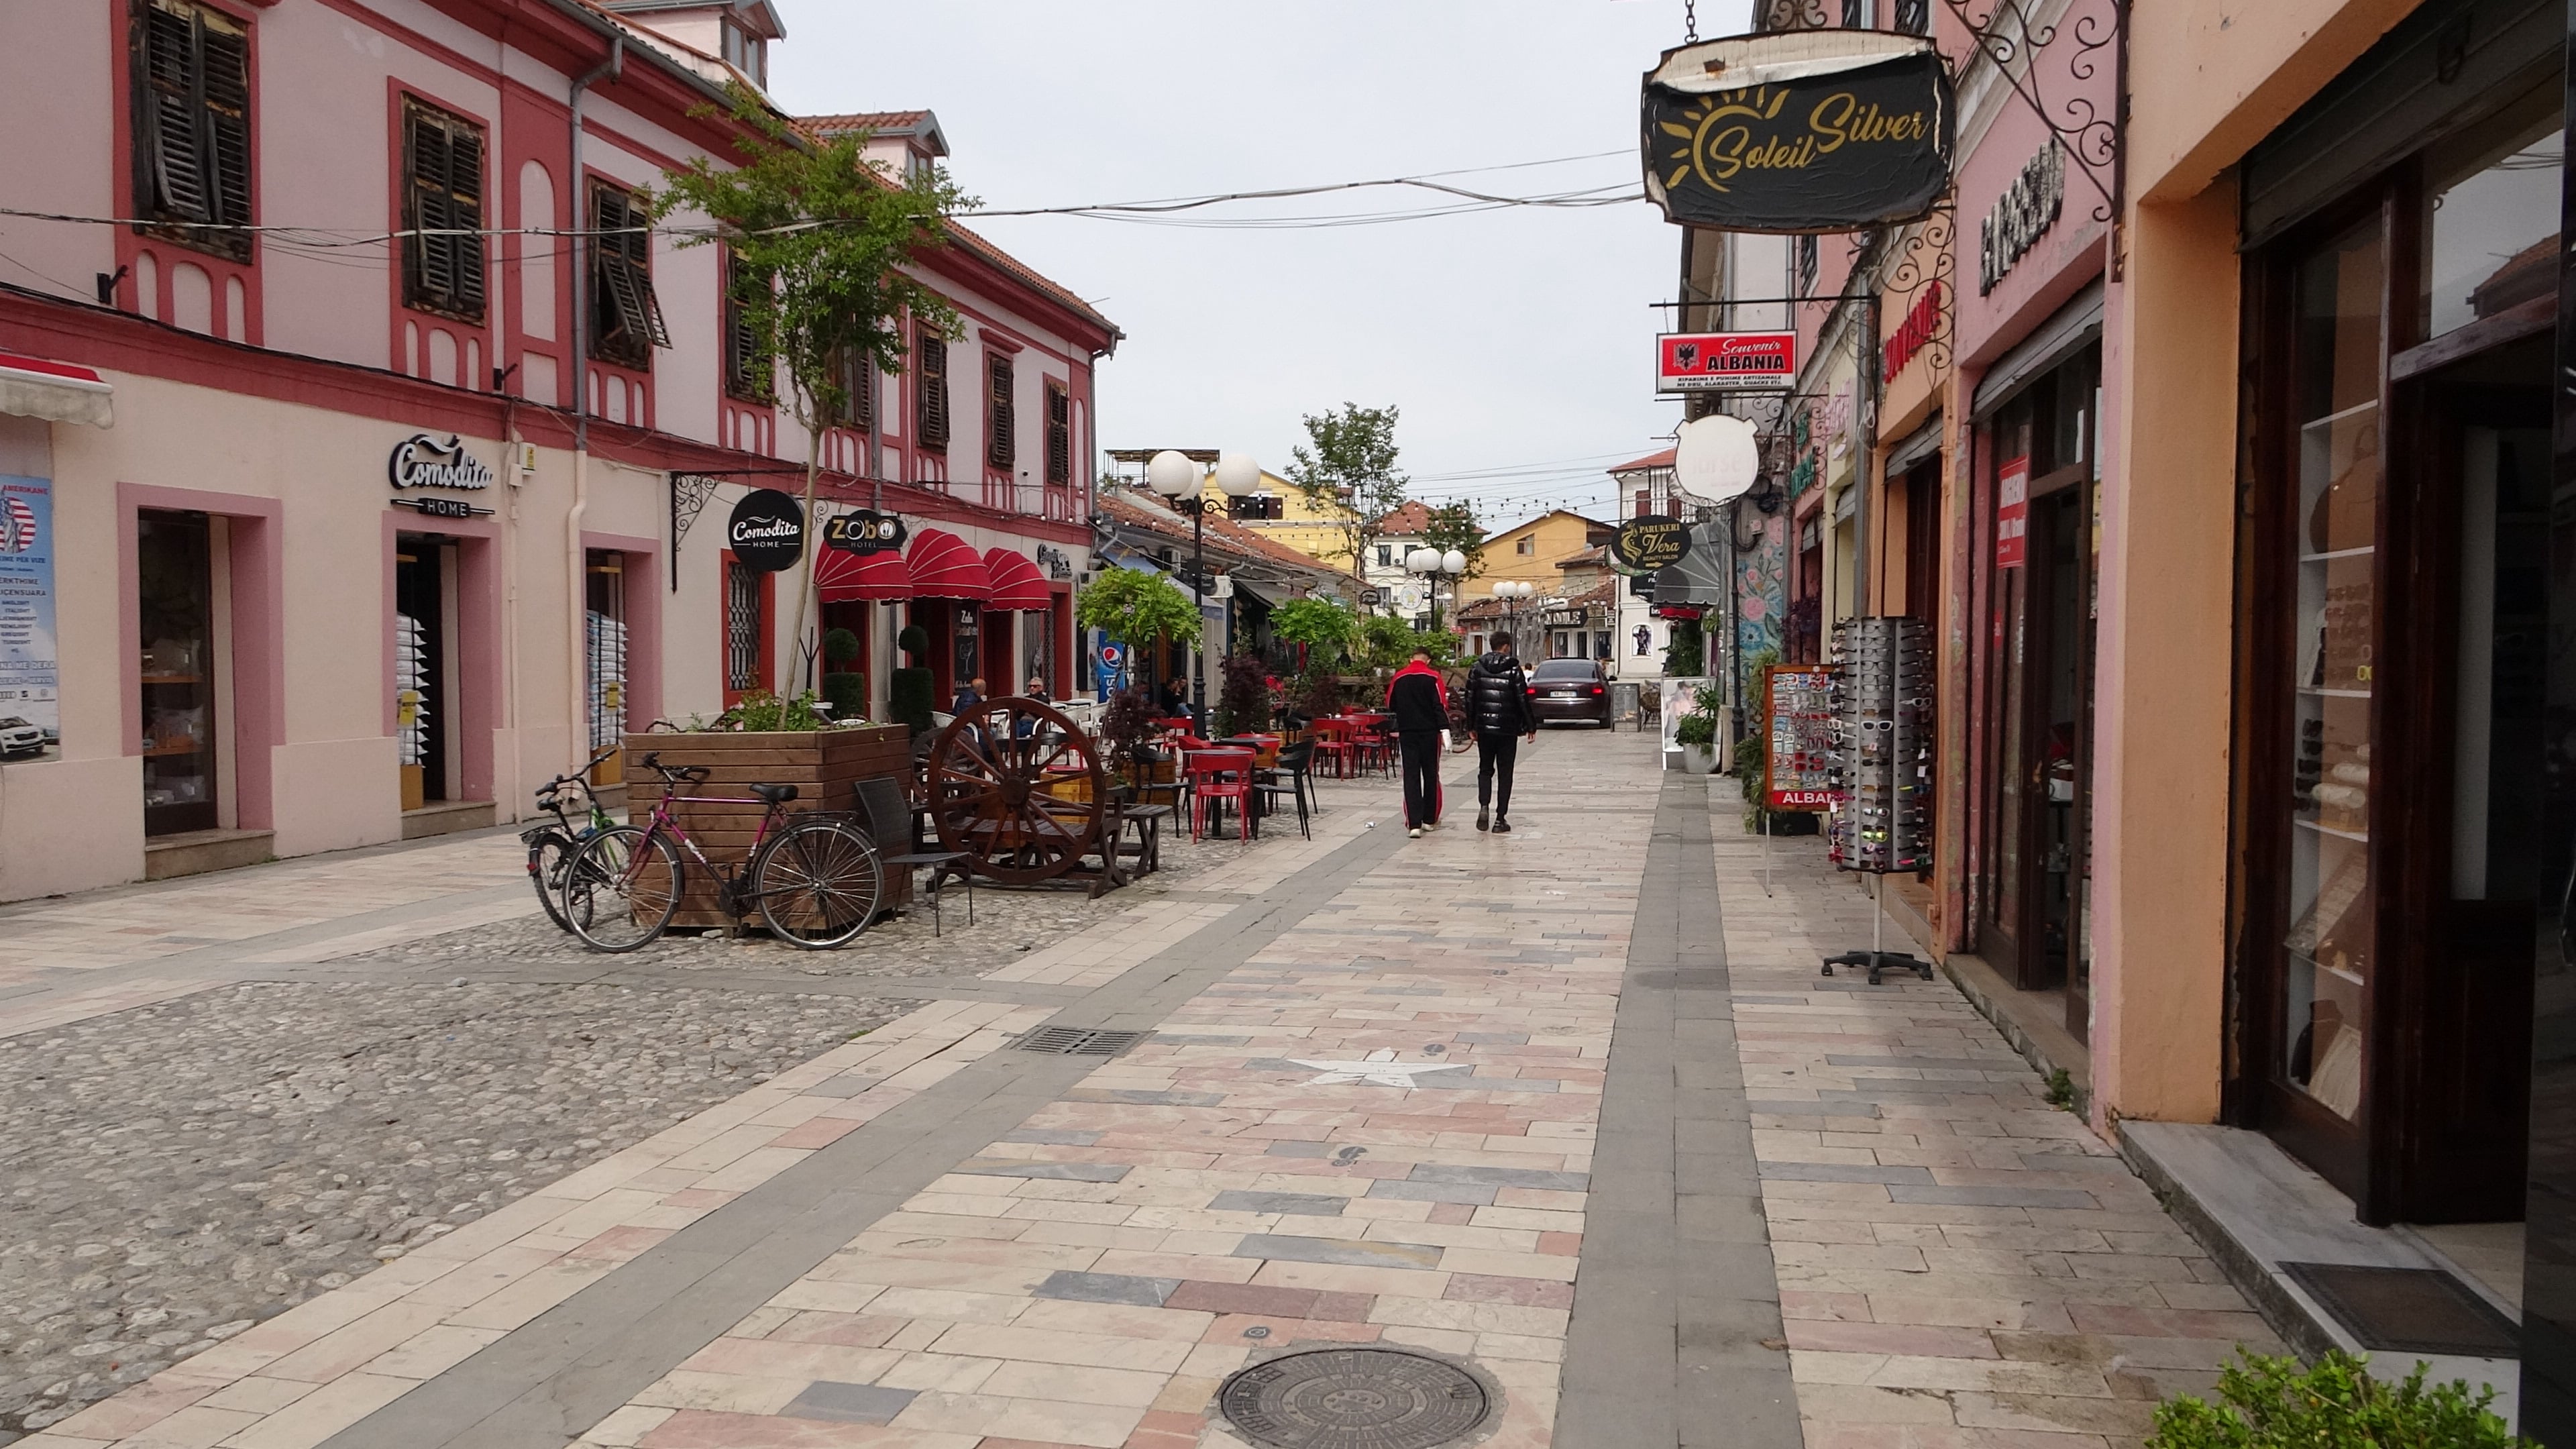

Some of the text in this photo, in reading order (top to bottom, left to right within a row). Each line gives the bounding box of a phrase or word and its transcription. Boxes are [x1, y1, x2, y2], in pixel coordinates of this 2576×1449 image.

[1710, 93, 1930, 179] Soleil Silver
[1721, 338, 1782, 355] Souvenir
[1707, 355, 1784, 371] ALBANIA
[389, 441, 494, 490] Comodita
[427, 500, 468, 517] HOME
[733, 518, 800, 541] Comodita
[1640, 523, 1680, 534] PARUKERI
[1642, 533, 1680, 554] Vera
